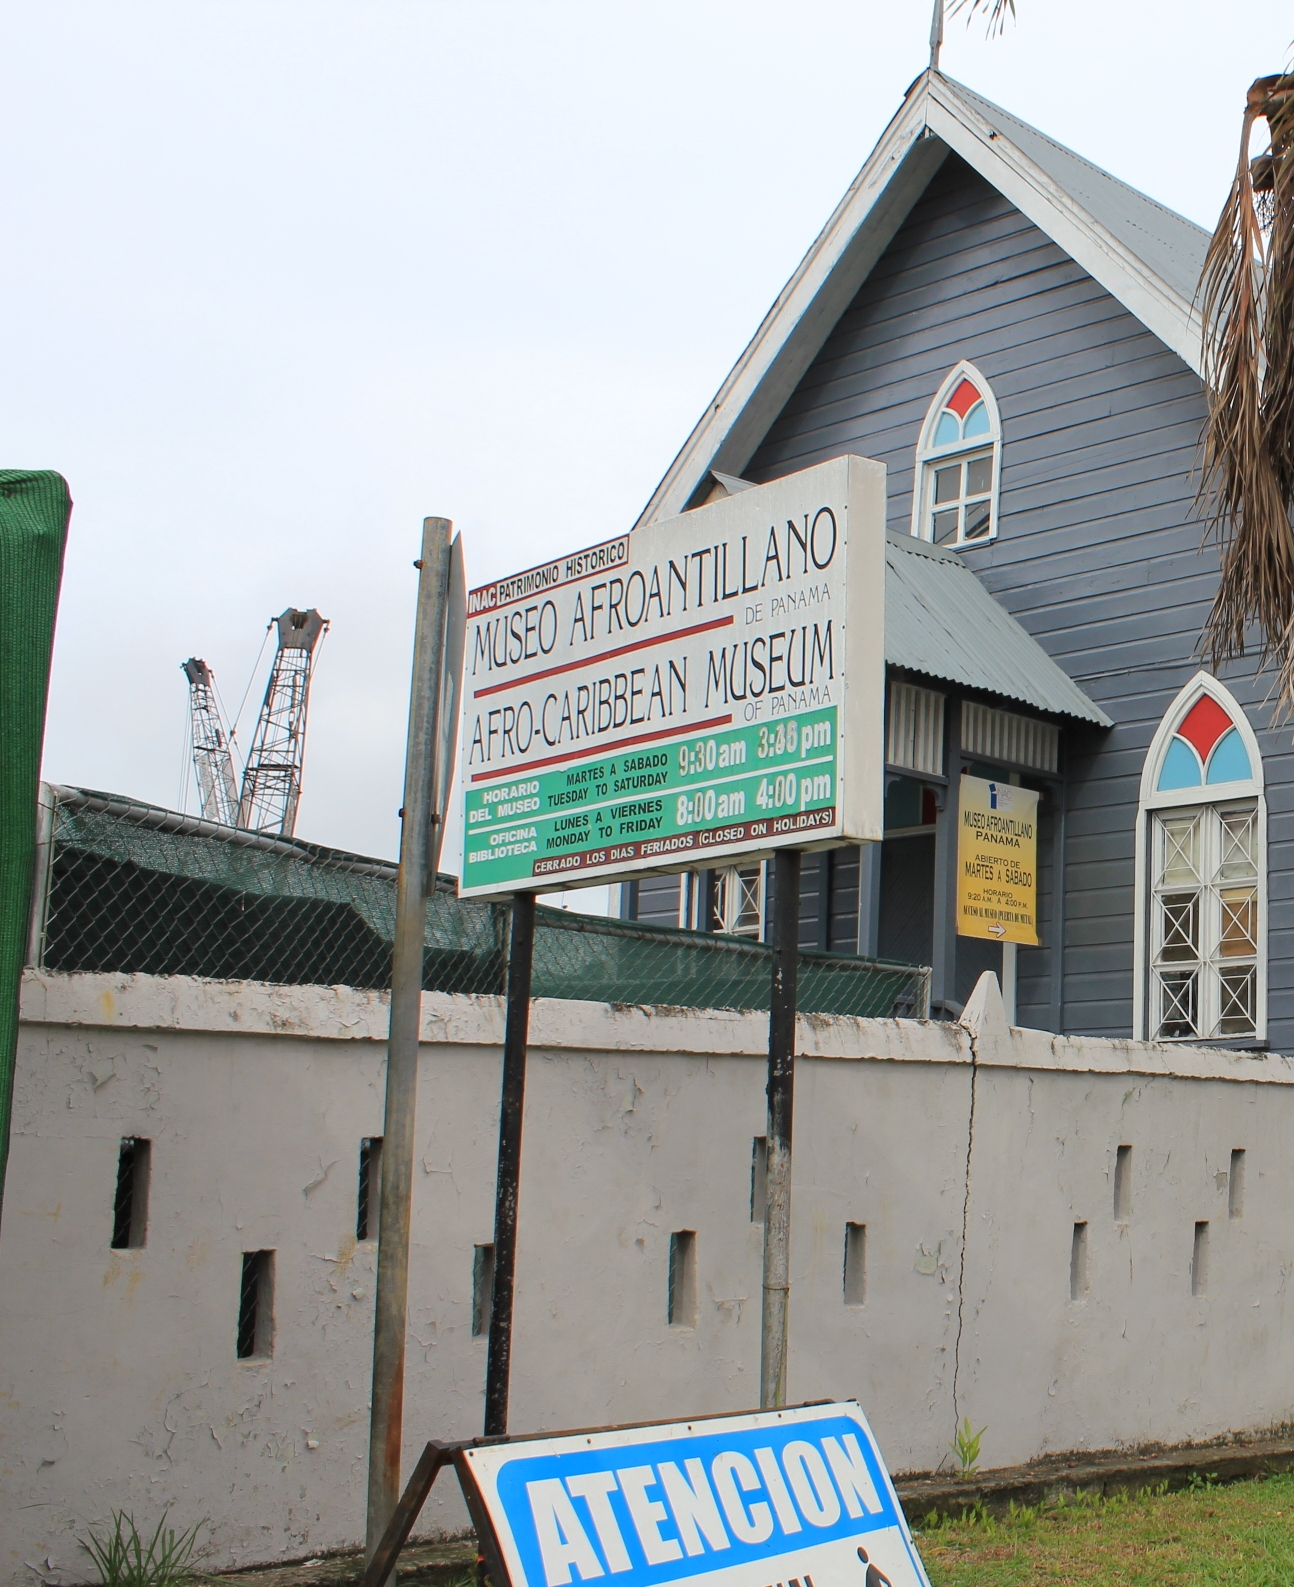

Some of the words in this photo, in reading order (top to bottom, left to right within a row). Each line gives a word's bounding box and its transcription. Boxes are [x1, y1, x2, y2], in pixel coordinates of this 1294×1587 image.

[469, 587, 497, 615] INAC
[500, 565, 559, 602] PATRIMONIO
[566, 542, 625, 578] HISTORICO
[472, 600, 557, 676] MUSEO
[570, 506, 837, 646] AFROANTILLANO
[745, 602, 763, 625] DE
[771, 582, 831, 617] PANAMA
[469, 656, 687, 765] AFRO-CARIBBEAN
[705, 619, 834, 708] MUSEUM
[744, 700, 763, 721] OF
[771, 685, 831, 715] PANAMA
[801, 720, 831, 758] pm
[567, 766, 604, 787] MARTES
[610, 763, 617, 776] A
[623, 753, 668, 772] SABADO
[678, 739, 717, 776] 9:30
[719, 740, 746, 768] am
[483, 780, 540, 804] HORARIO
[548, 787, 589, 807] TUESDAY
[596, 783, 608, 797] TO
[613, 771, 668, 793] SATURDAY
[756, 773, 796, 809] 4:00
[801, 773, 831, 811] pm
[469, 807, 492, 823] DEL
[498, 797, 540, 818] MUSEO
[554, 814, 589, 832] LUNES
[595, 811, 602, 823] A
[611, 799, 663, 819] VIERNES
[676, 789, 716, 826] 8:00
[718, 790, 745, 818] am
[964, 811, 985, 829] MUSEO
[986, 815, 1033, 839] AFROANTILLANO
[489, 826, 538, 846] OFICINA
[535, 856, 580, 873] CERRADO
[586, 851, 606, 864] LOS
[611, 846, 634, 860] DIAS
[641, 835, 693, 855] FERIADOS
[699, 827, 744, 846] (CLOSED
[751, 823, 767, 836] ON
[773, 809, 832, 833] HOLIDAYS)
[546, 830, 590, 850] MONDAY
[599, 825, 612, 839] TO
[620, 816, 663, 835] FRIDAY
[976, 830, 1020, 848] PANAMA
[468, 841, 538, 863] BIBLIOTECA
[975, 854, 1009, 867] ABIERTO
[1010, 861, 1020, 869] DE
[965, 861, 993, 880] MARTES
[997, 870, 1002, 882] A
[1005, 868, 1032, 887] SABADO
[983, 888, 1013, 899] HORARIO
[526, 1433, 884, 1587] ATENCION
